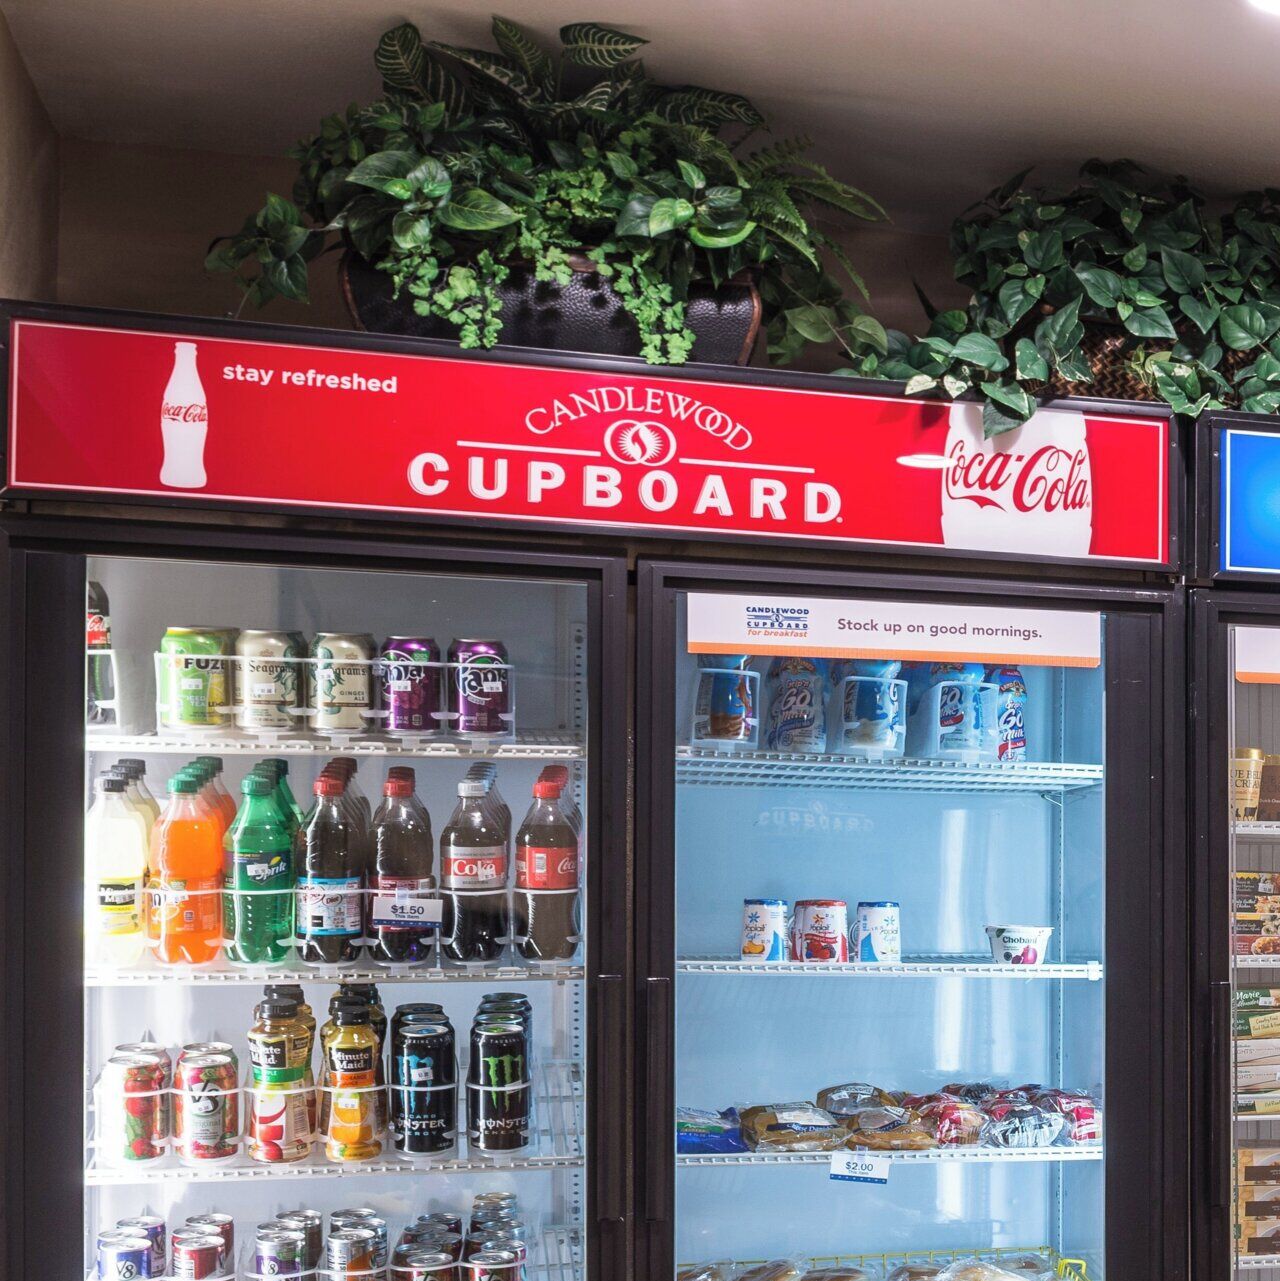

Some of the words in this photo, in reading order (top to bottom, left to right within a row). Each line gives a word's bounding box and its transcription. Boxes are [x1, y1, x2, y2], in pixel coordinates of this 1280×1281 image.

[223, 363, 274, 388] stay
[282, 369, 397, 395] refreshed
[525, 386, 753, 451] CANDLEWOOD
[945, 439, 1089, 515] Coca-Cola
[407, 452, 840, 524] CUPBOARD
[746, 606, 809, 616] CANDLEWOOD
[747, 621, 808, 630] CUPBOARD
[747, 628, 762, 638] for
[763, 628, 807, 639] breakfast
[838, 617, 886, 635] Stock
[890, 622, 904, 639] up
[907, 623, 925, 636] on
[929, 619, 967, 641] good
[972, 623, 1043, 644] mornings.
[783, 688, 811, 711] GO
[256, 862, 288, 881] Sprite
[454, 858, 495, 877] Coke
[391, 905, 424, 917] $1.50
[1002, 934, 1040, 945] Chobani
[1236, 990, 1261, 999] Marie
[845, 1161, 874, 1173] $2.00
